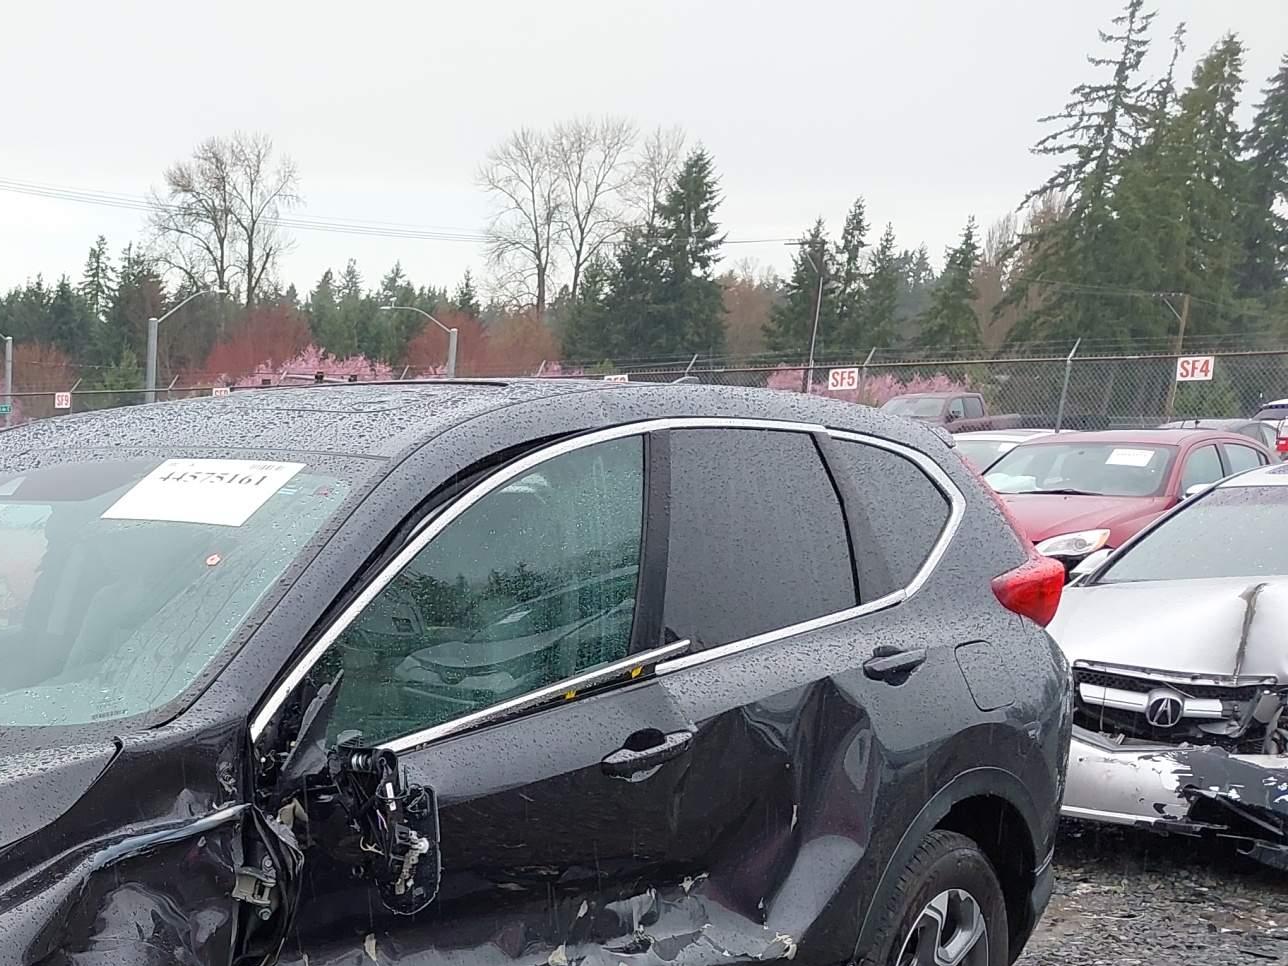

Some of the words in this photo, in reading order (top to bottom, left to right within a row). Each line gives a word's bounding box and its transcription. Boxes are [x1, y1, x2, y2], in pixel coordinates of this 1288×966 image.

[1179, 359, 1210, 378] SF4
[831, 371, 856, 388] SF5
[56, 394, 70, 406] SF9
[160, 471, 268, 486] 44575161
